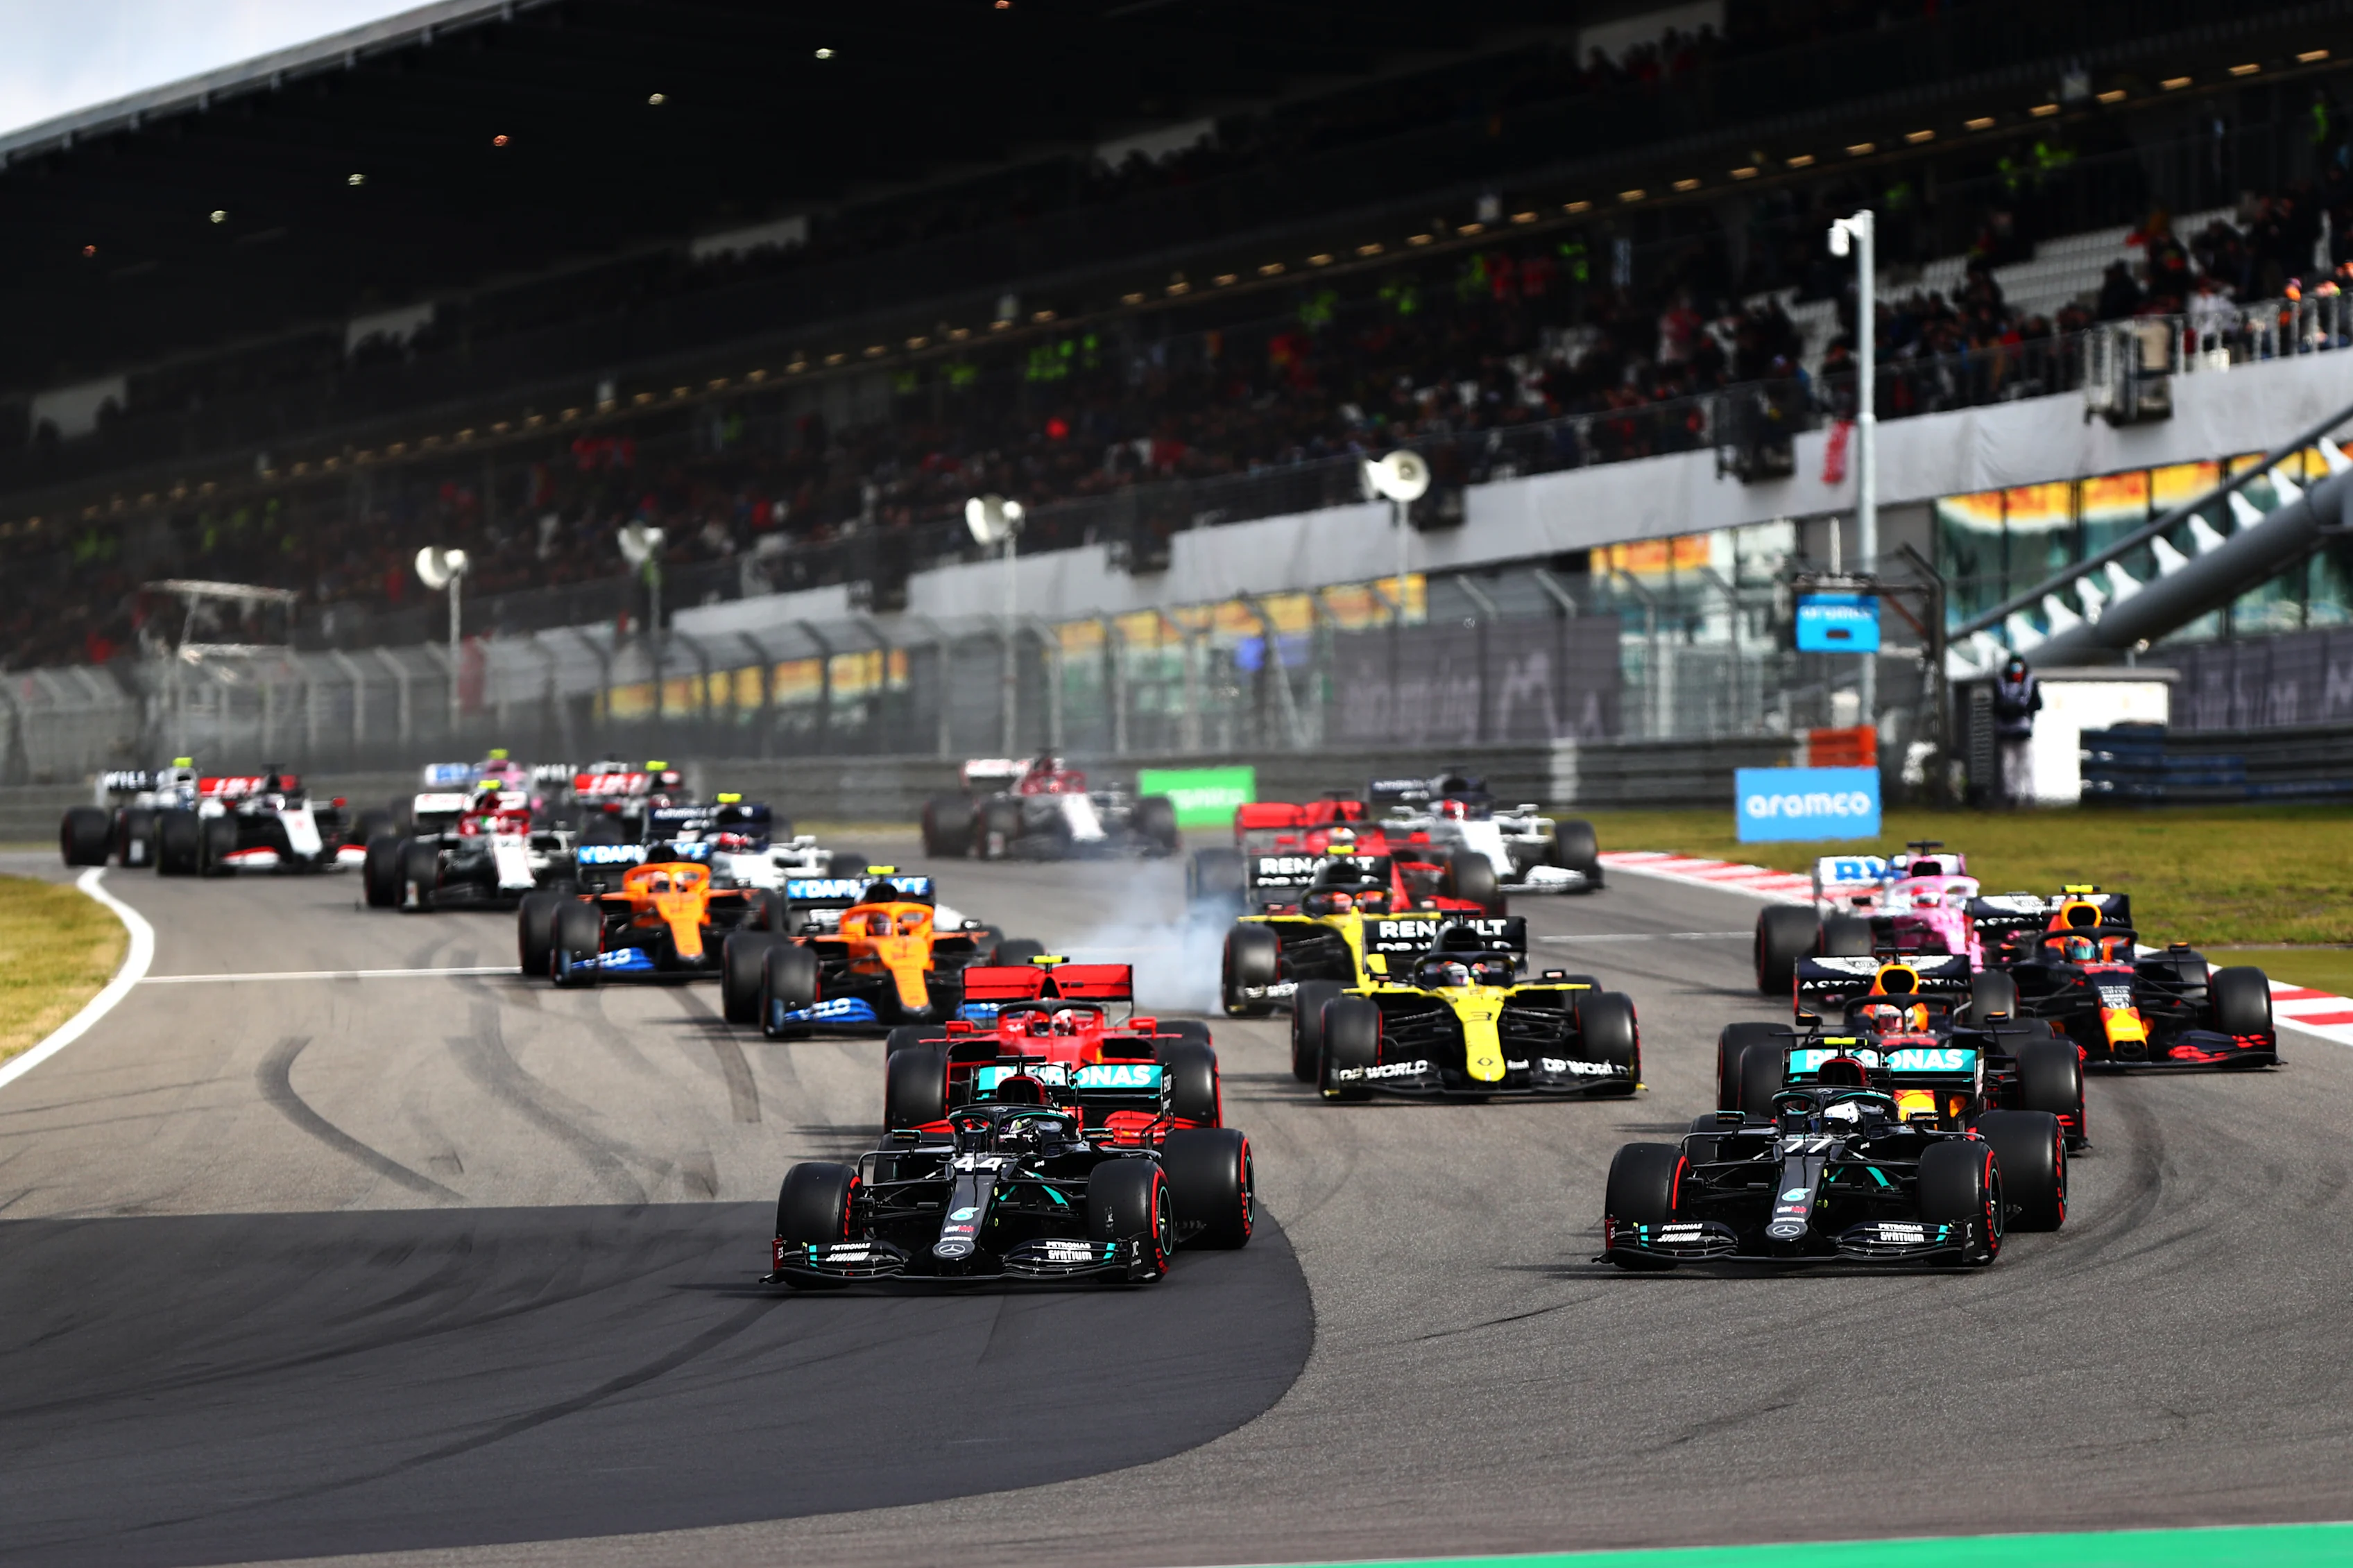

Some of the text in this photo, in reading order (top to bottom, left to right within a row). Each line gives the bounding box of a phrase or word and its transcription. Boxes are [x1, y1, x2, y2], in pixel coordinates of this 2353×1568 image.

[1746, 791, 1871, 818] aramco
[1365, 1060, 1428, 1078] WORLD
[1783, 1138, 1833, 1153] 77
[954, 1157, 1003, 1172] 44
[1662, 1223, 1703, 1232] PETRONAS
[1657, 1232, 1701, 1242] SYNTIUM
[1880, 1232, 1924, 1242] SYNTIUM
[830, 1242, 871, 1251] PETRONAS
[825, 1251, 869, 1262] SYNTIUM
[1047, 1250, 1092, 1260] SYNTIUM
